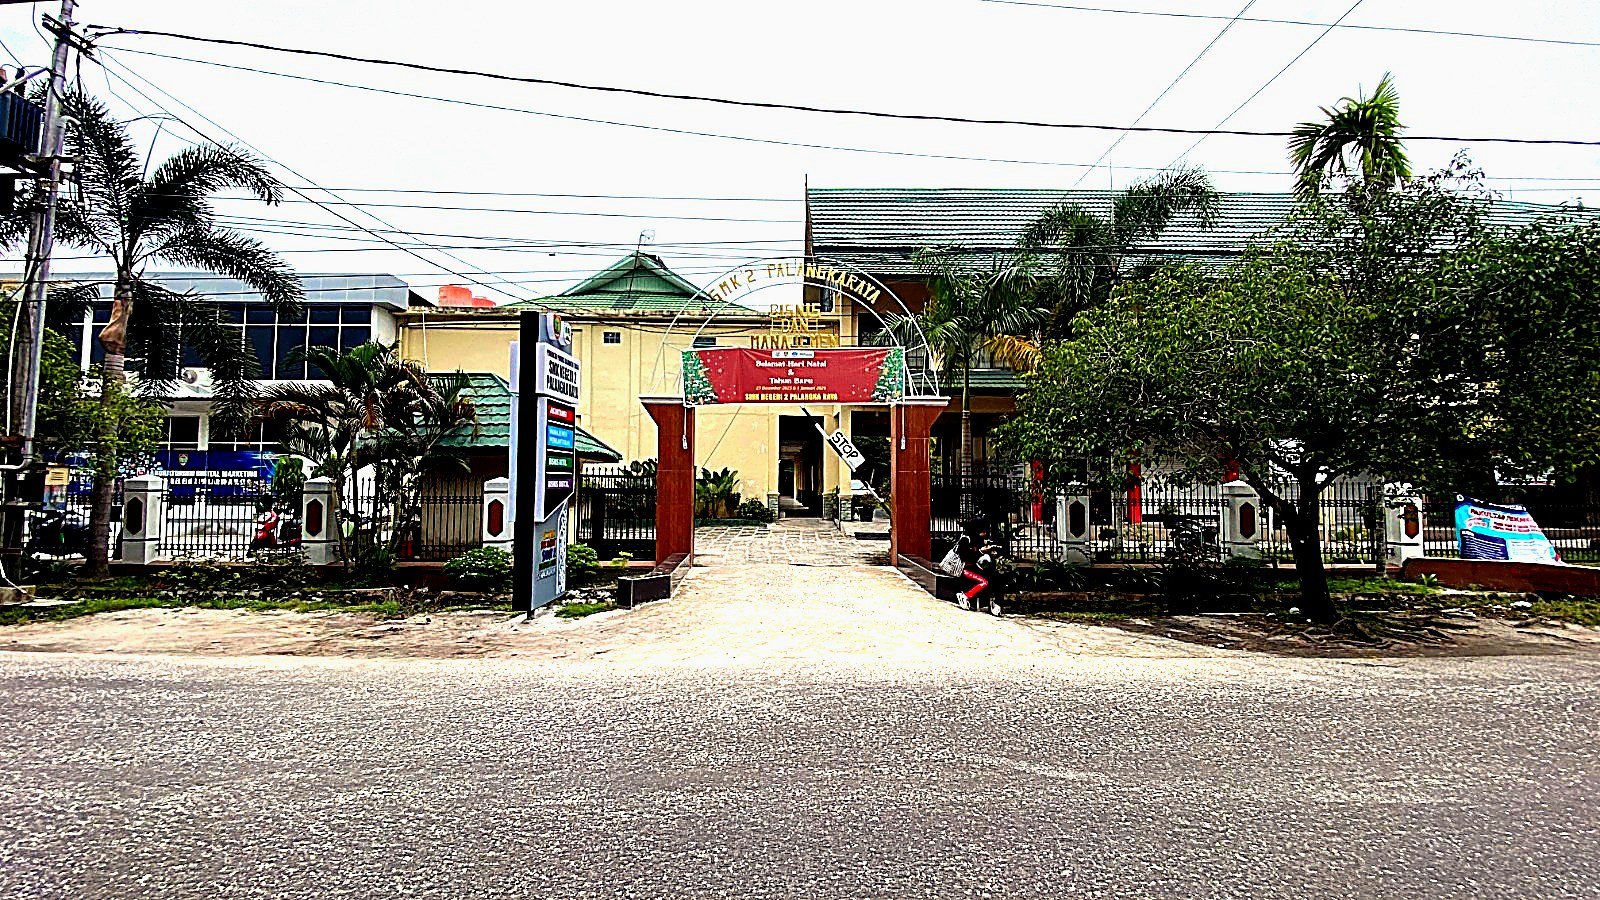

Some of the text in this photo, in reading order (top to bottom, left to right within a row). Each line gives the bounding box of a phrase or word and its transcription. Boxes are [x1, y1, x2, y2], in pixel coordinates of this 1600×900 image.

[707, 263, 881, 304] SMK 2 PALANGKARAYA
[769, 303, 821, 318] BISNIS
[781, 318, 809, 333] DAN
[750, 334, 840, 350] MANAJEMEN
[755, 360, 827, 368] Selamat Hari Natal
[769, 377, 814, 385] Tahun Baru
[783, 393, 789, 401] 2
[831, 431, 859, 459] STOP
